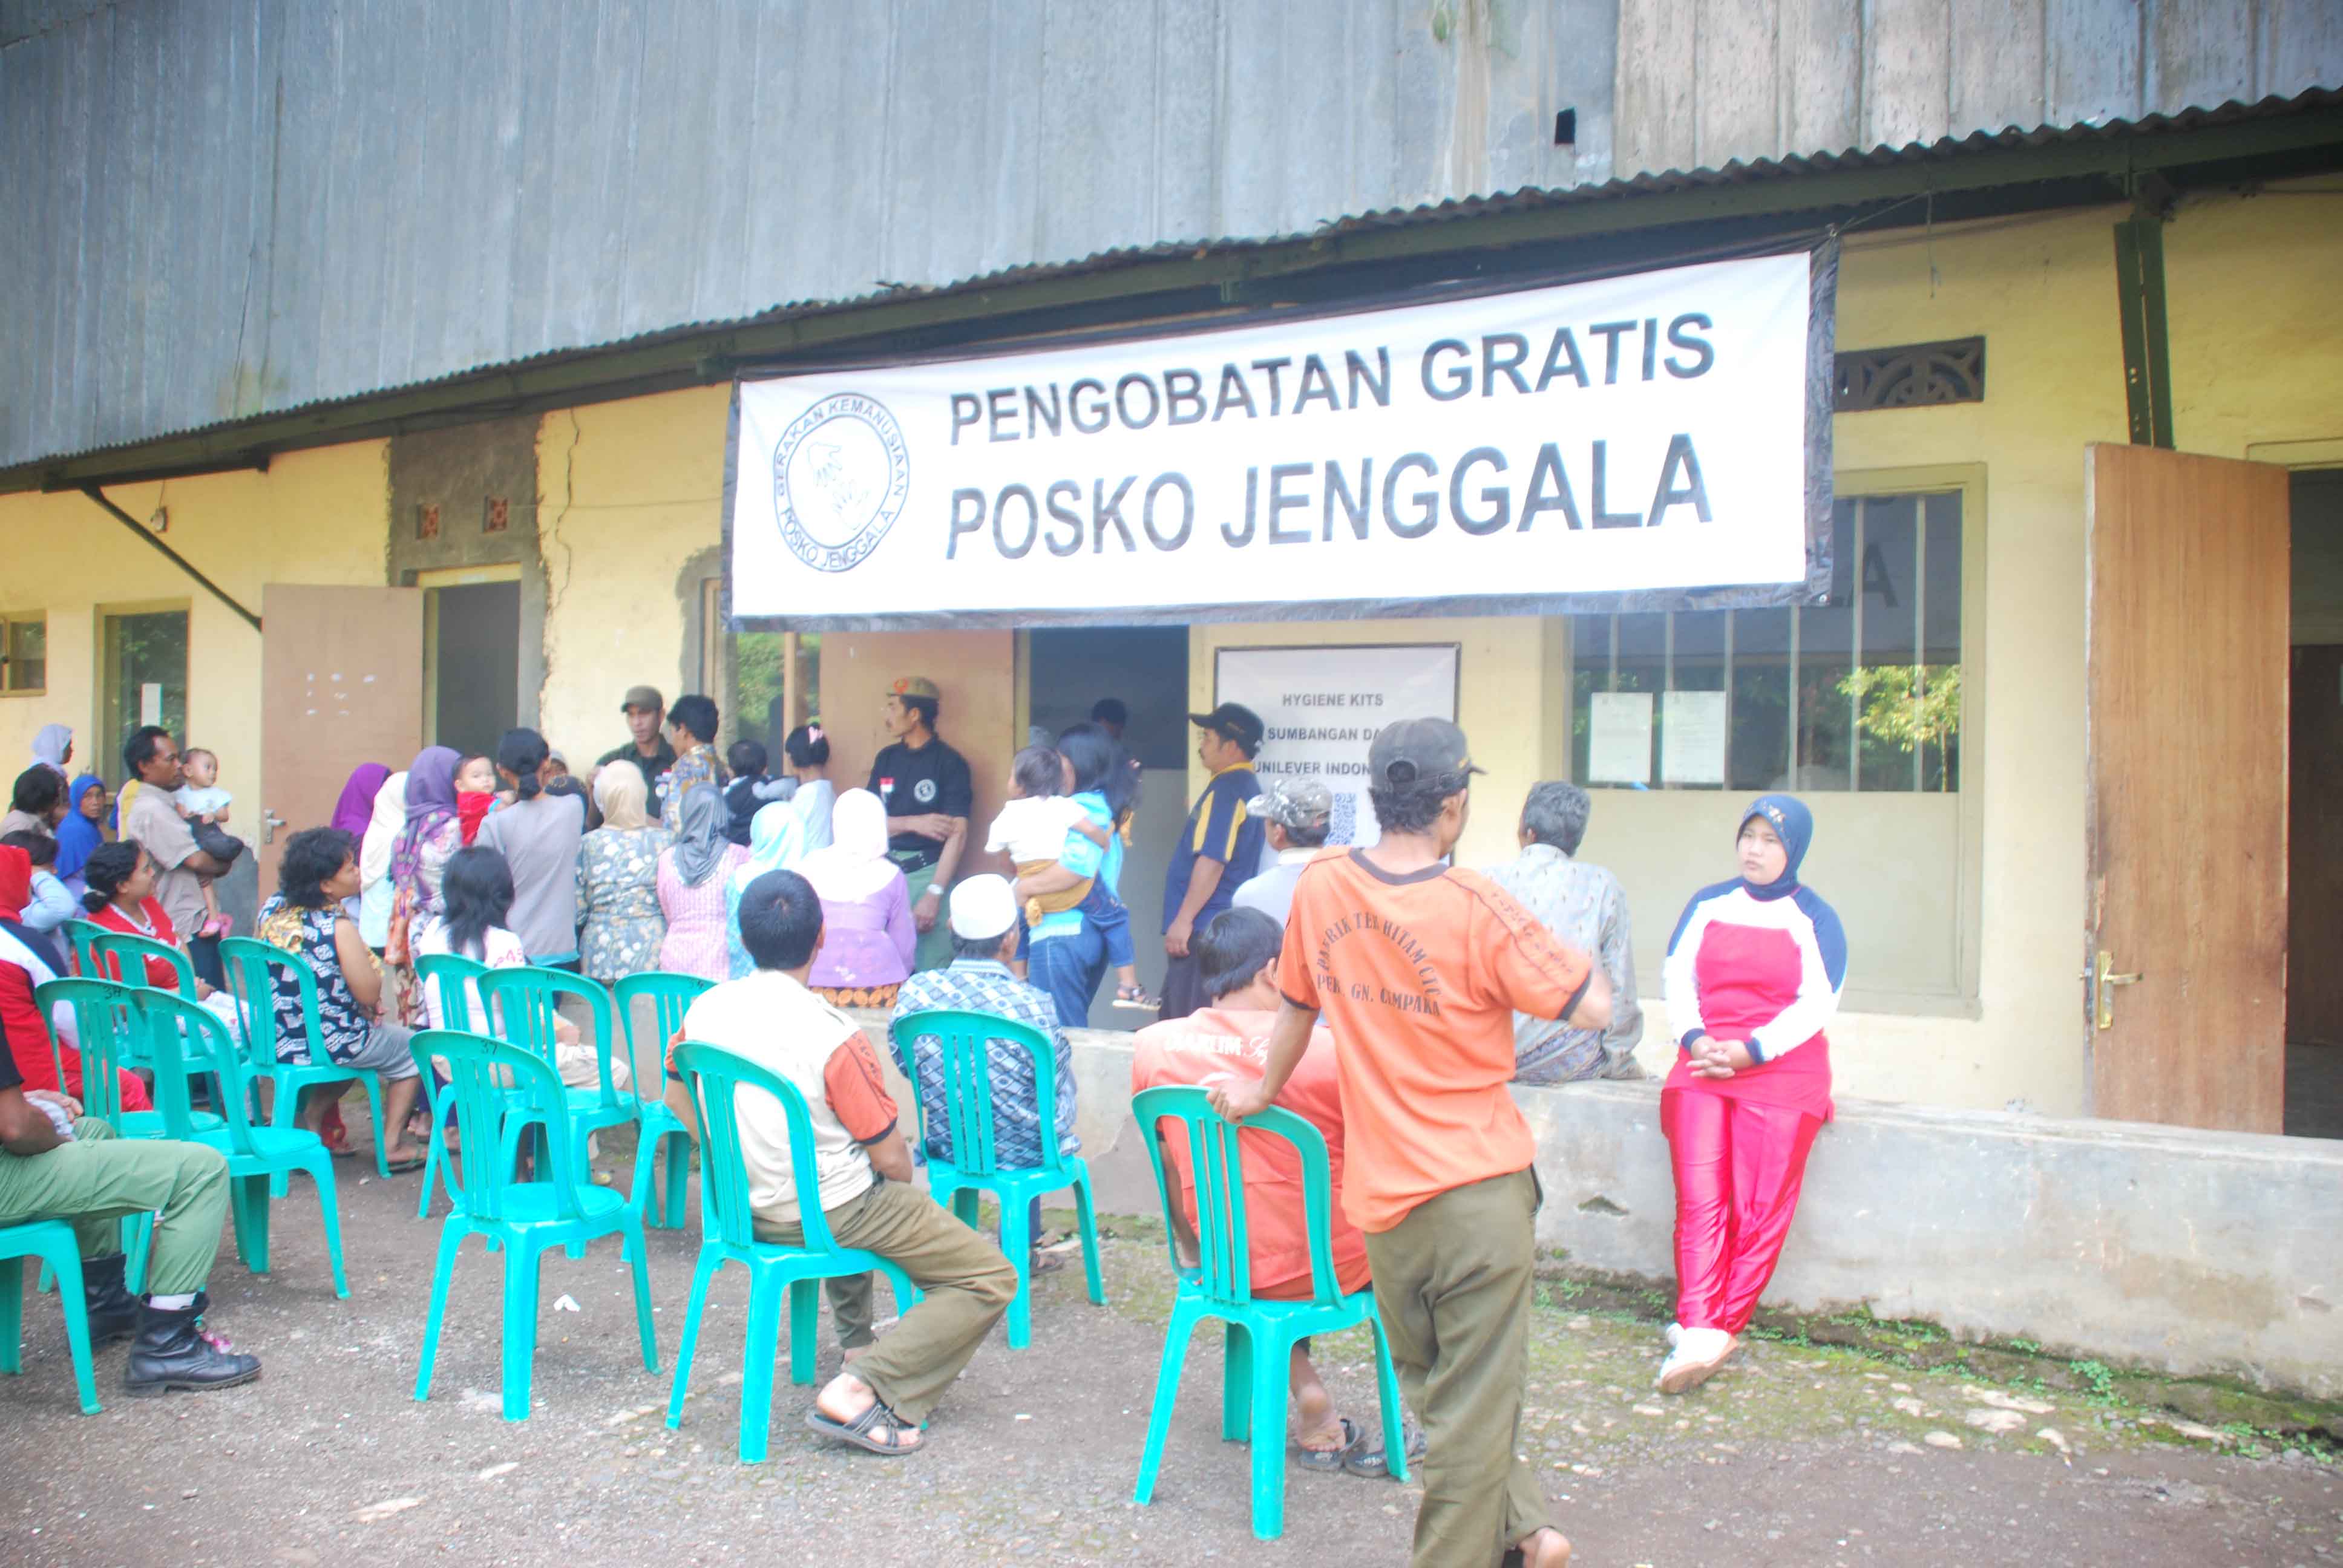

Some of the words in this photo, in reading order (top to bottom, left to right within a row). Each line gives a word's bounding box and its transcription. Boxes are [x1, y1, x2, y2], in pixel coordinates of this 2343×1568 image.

[950, 347, 1390, 445] PENGOBATAN
[1421, 313, 1714, 401] GRATIS
[776, 407, 824, 497] GERAKAN
[828, 398, 906, 497] KEMANUSIAAN
[946, 472, 1194, 561] POSKO
[1221, 434, 1712, 548] JENGGALA
[781, 507, 818, 563] POSKO
[821, 510, 896, 568] JENGGALA
[1283, 693, 1346, 707] HYGIENE
[1350, 693, 1384, 707] KITS
[1268, 728, 1358, 741] SUMBANGAN
[1363, 729, 1381, 740] DA
[1254, 761, 1320, 775] UNILEVER
[1326, 762, 1371, 775] INDON
[1383, 920, 1427, 966] HITAM
